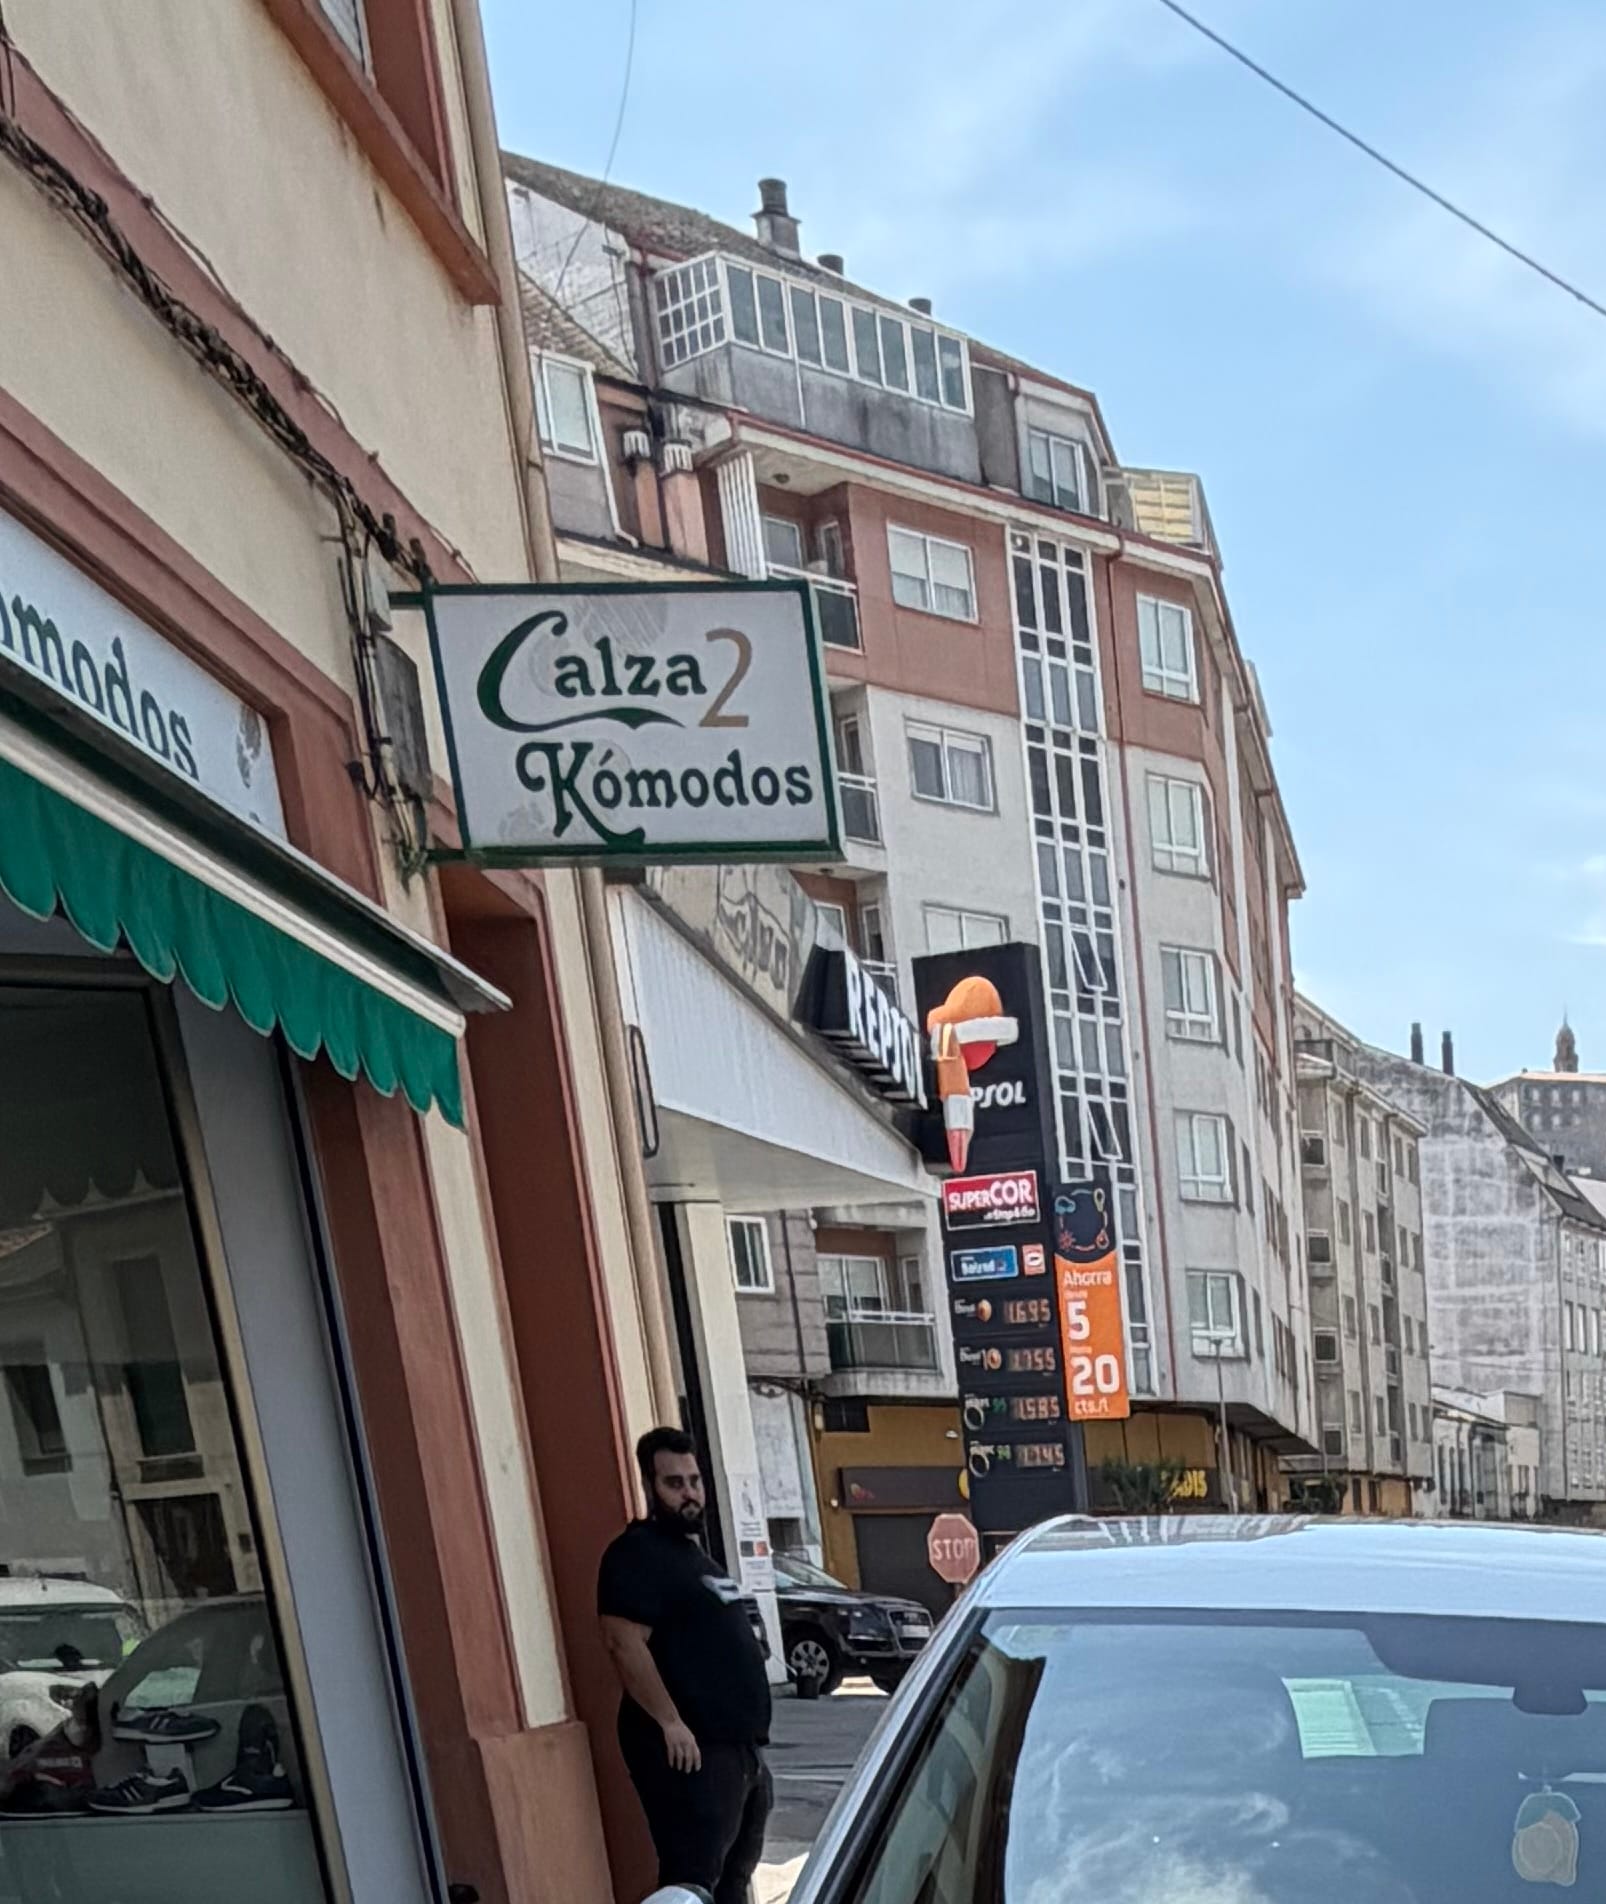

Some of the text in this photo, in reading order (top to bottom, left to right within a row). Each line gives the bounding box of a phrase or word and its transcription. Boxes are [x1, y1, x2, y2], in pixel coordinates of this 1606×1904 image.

[516, 741, 813, 845] Kómodos
[1063, 1269, 1112, 1286] Ahorra
[1067, 1301, 1090, 1340] 5
[1069, 1354, 1120, 1395] 20
[932, 1537, 975, 1560] STOP
